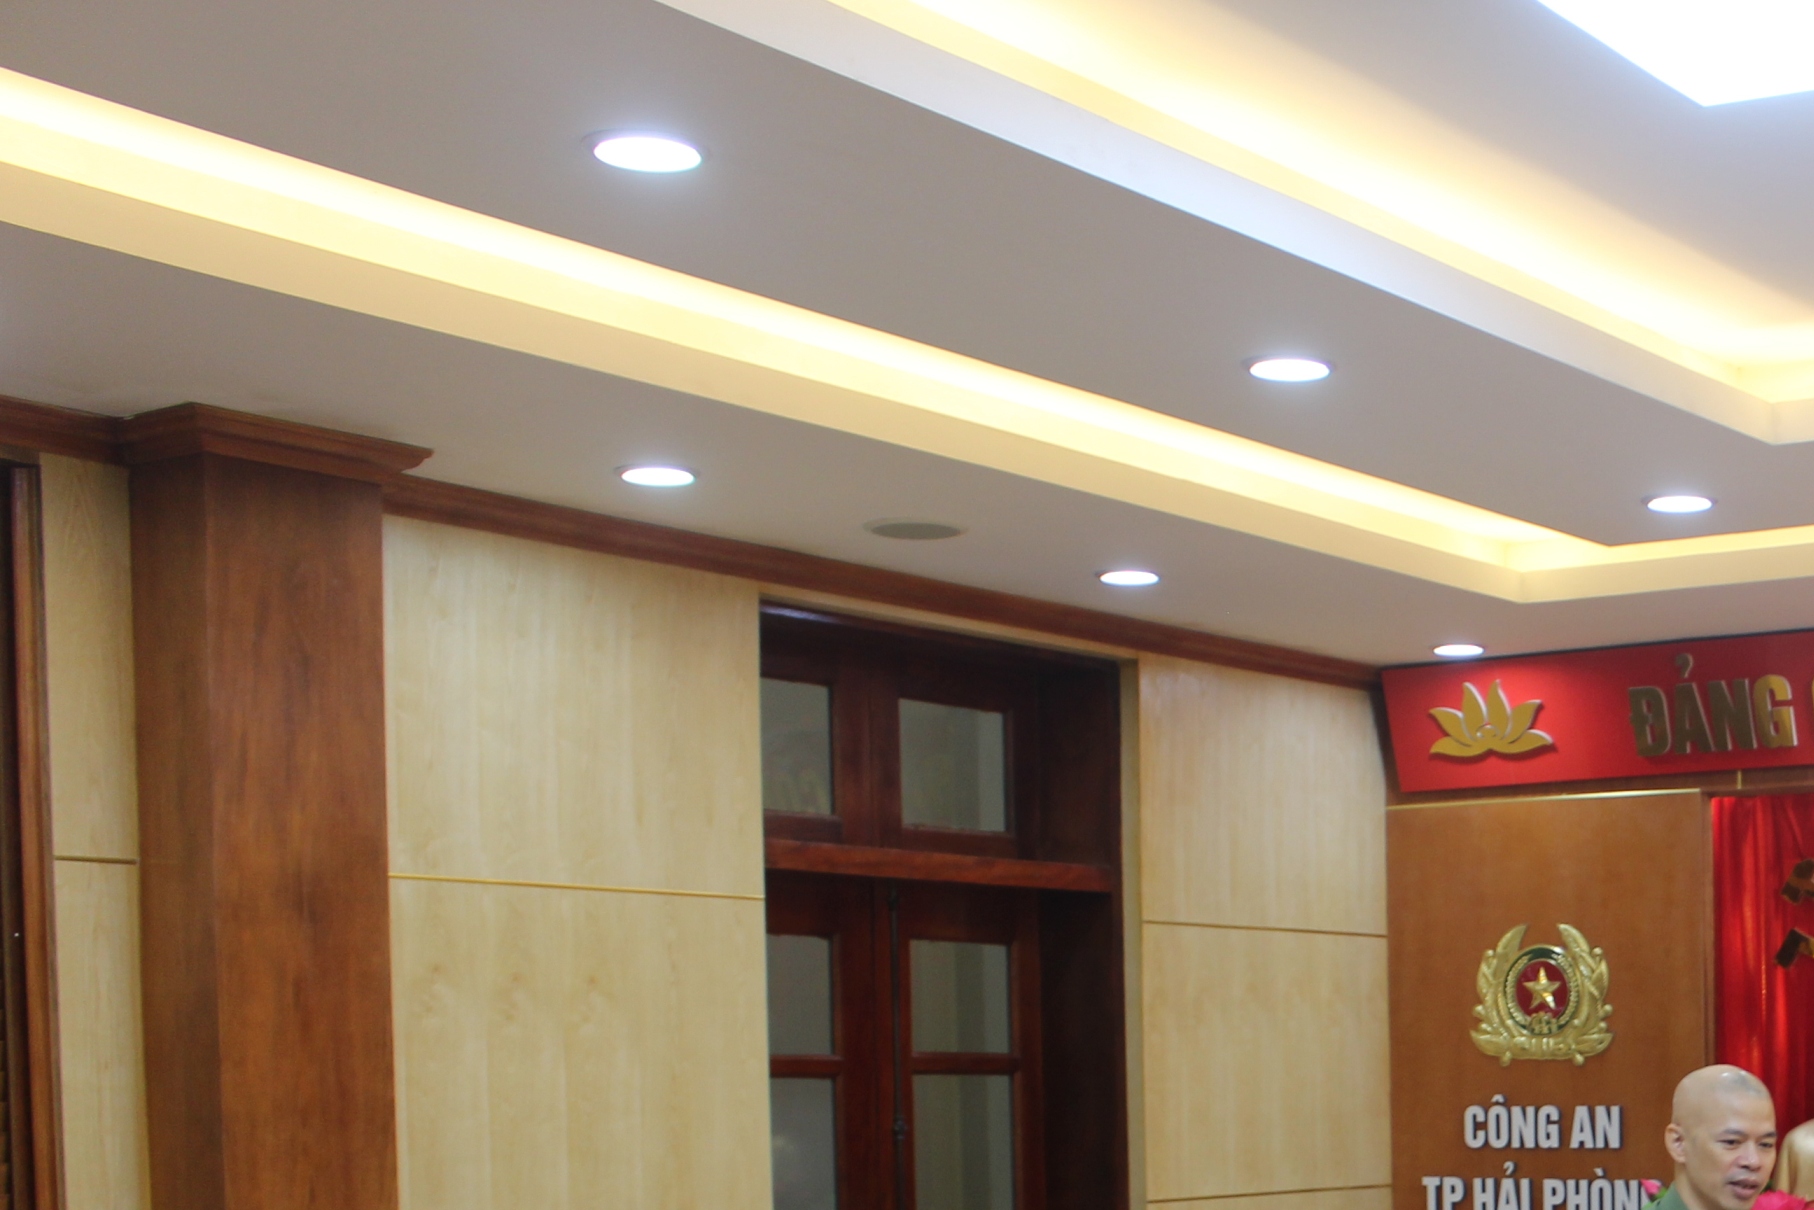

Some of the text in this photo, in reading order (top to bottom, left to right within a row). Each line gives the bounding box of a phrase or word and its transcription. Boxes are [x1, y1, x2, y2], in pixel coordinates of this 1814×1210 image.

[1628, 653, 1797, 756] ĐẢNG
[1464, 1094, 1621, 1149] CÔNG AN
